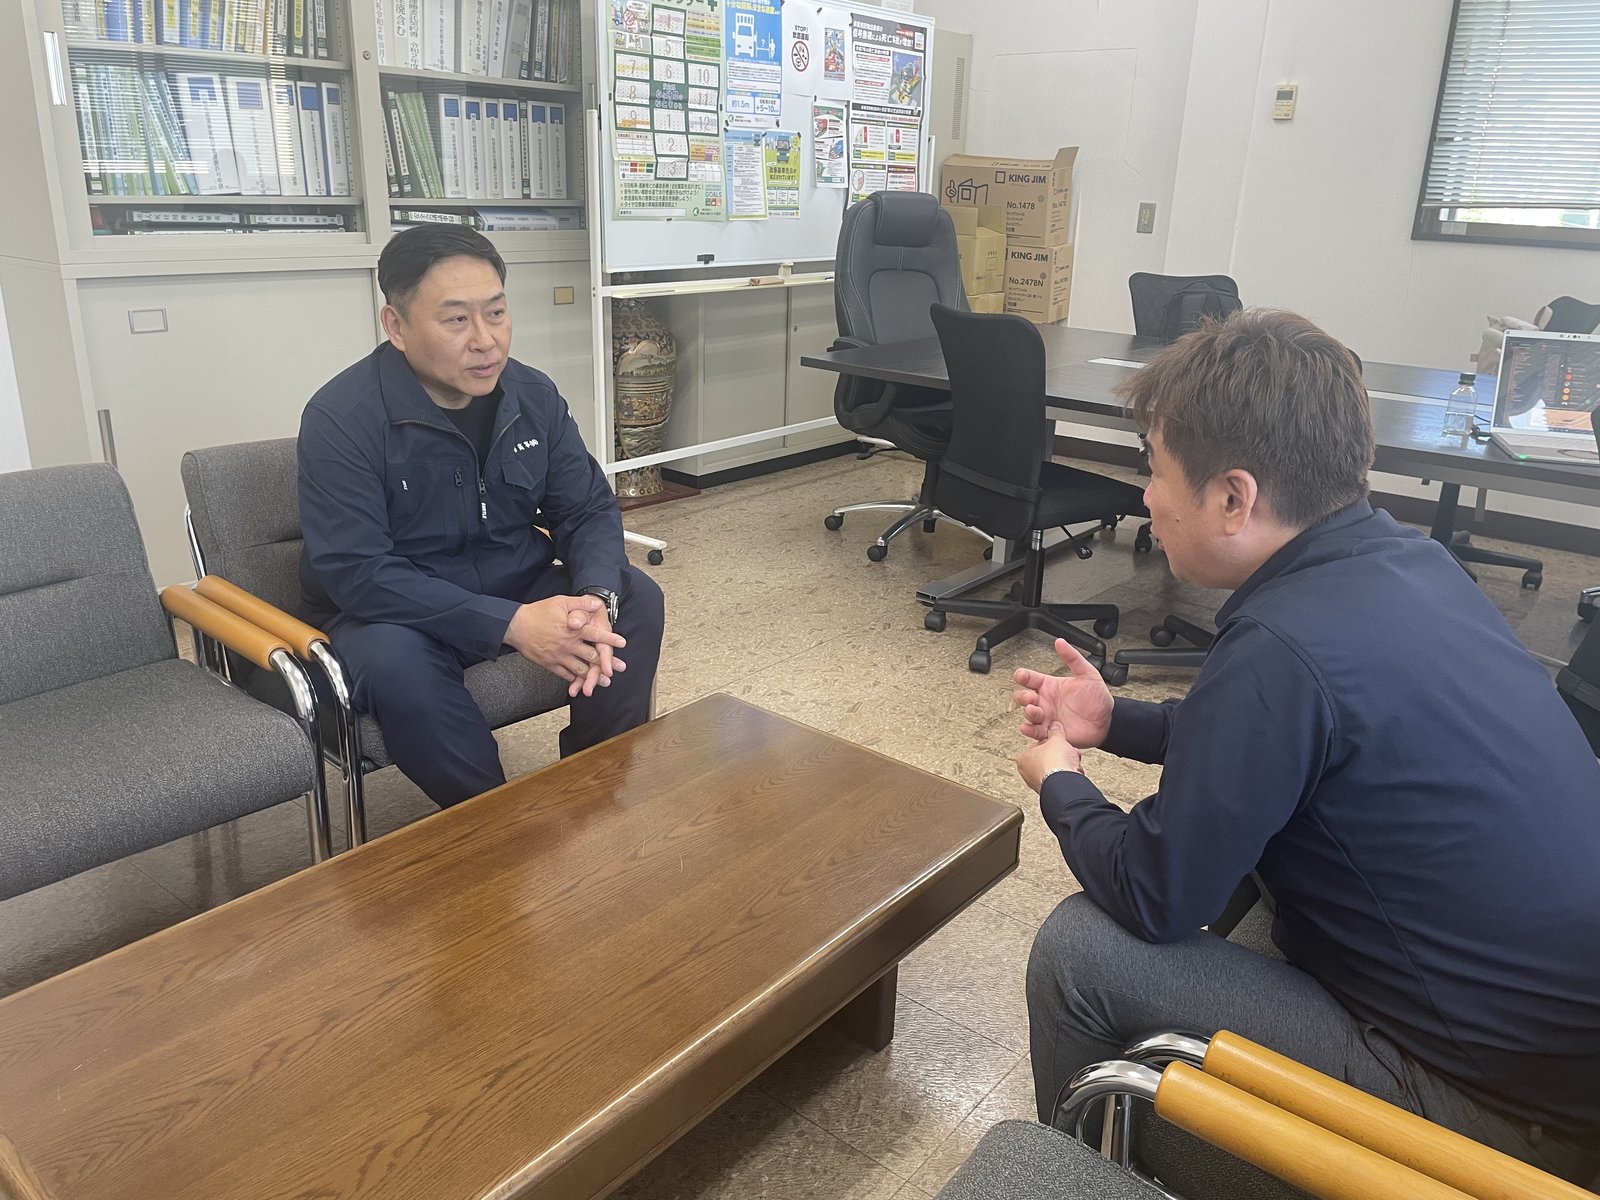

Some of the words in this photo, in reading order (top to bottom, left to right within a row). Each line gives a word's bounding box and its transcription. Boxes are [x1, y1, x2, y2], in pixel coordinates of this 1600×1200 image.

[665, 64, 672, 79] 6
[698, 68, 710, 83] 10
[629, 85, 636, 100] 8
[698, 93, 709, 106] 11
[699, 116, 710, 131] 12
[667, 138, 675, 152] 2
[670, 161, 676, 176] 3
[1008, 174, 1030, 183] KING
[1031, 175, 1046, 184] JIM
[1006, 201, 1036, 210] No.1478
[1011, 251, 1032, 261] KING
[1033, 253, 1049, 262] JIM
[1008, 277, 1044, 287] No.2478N
